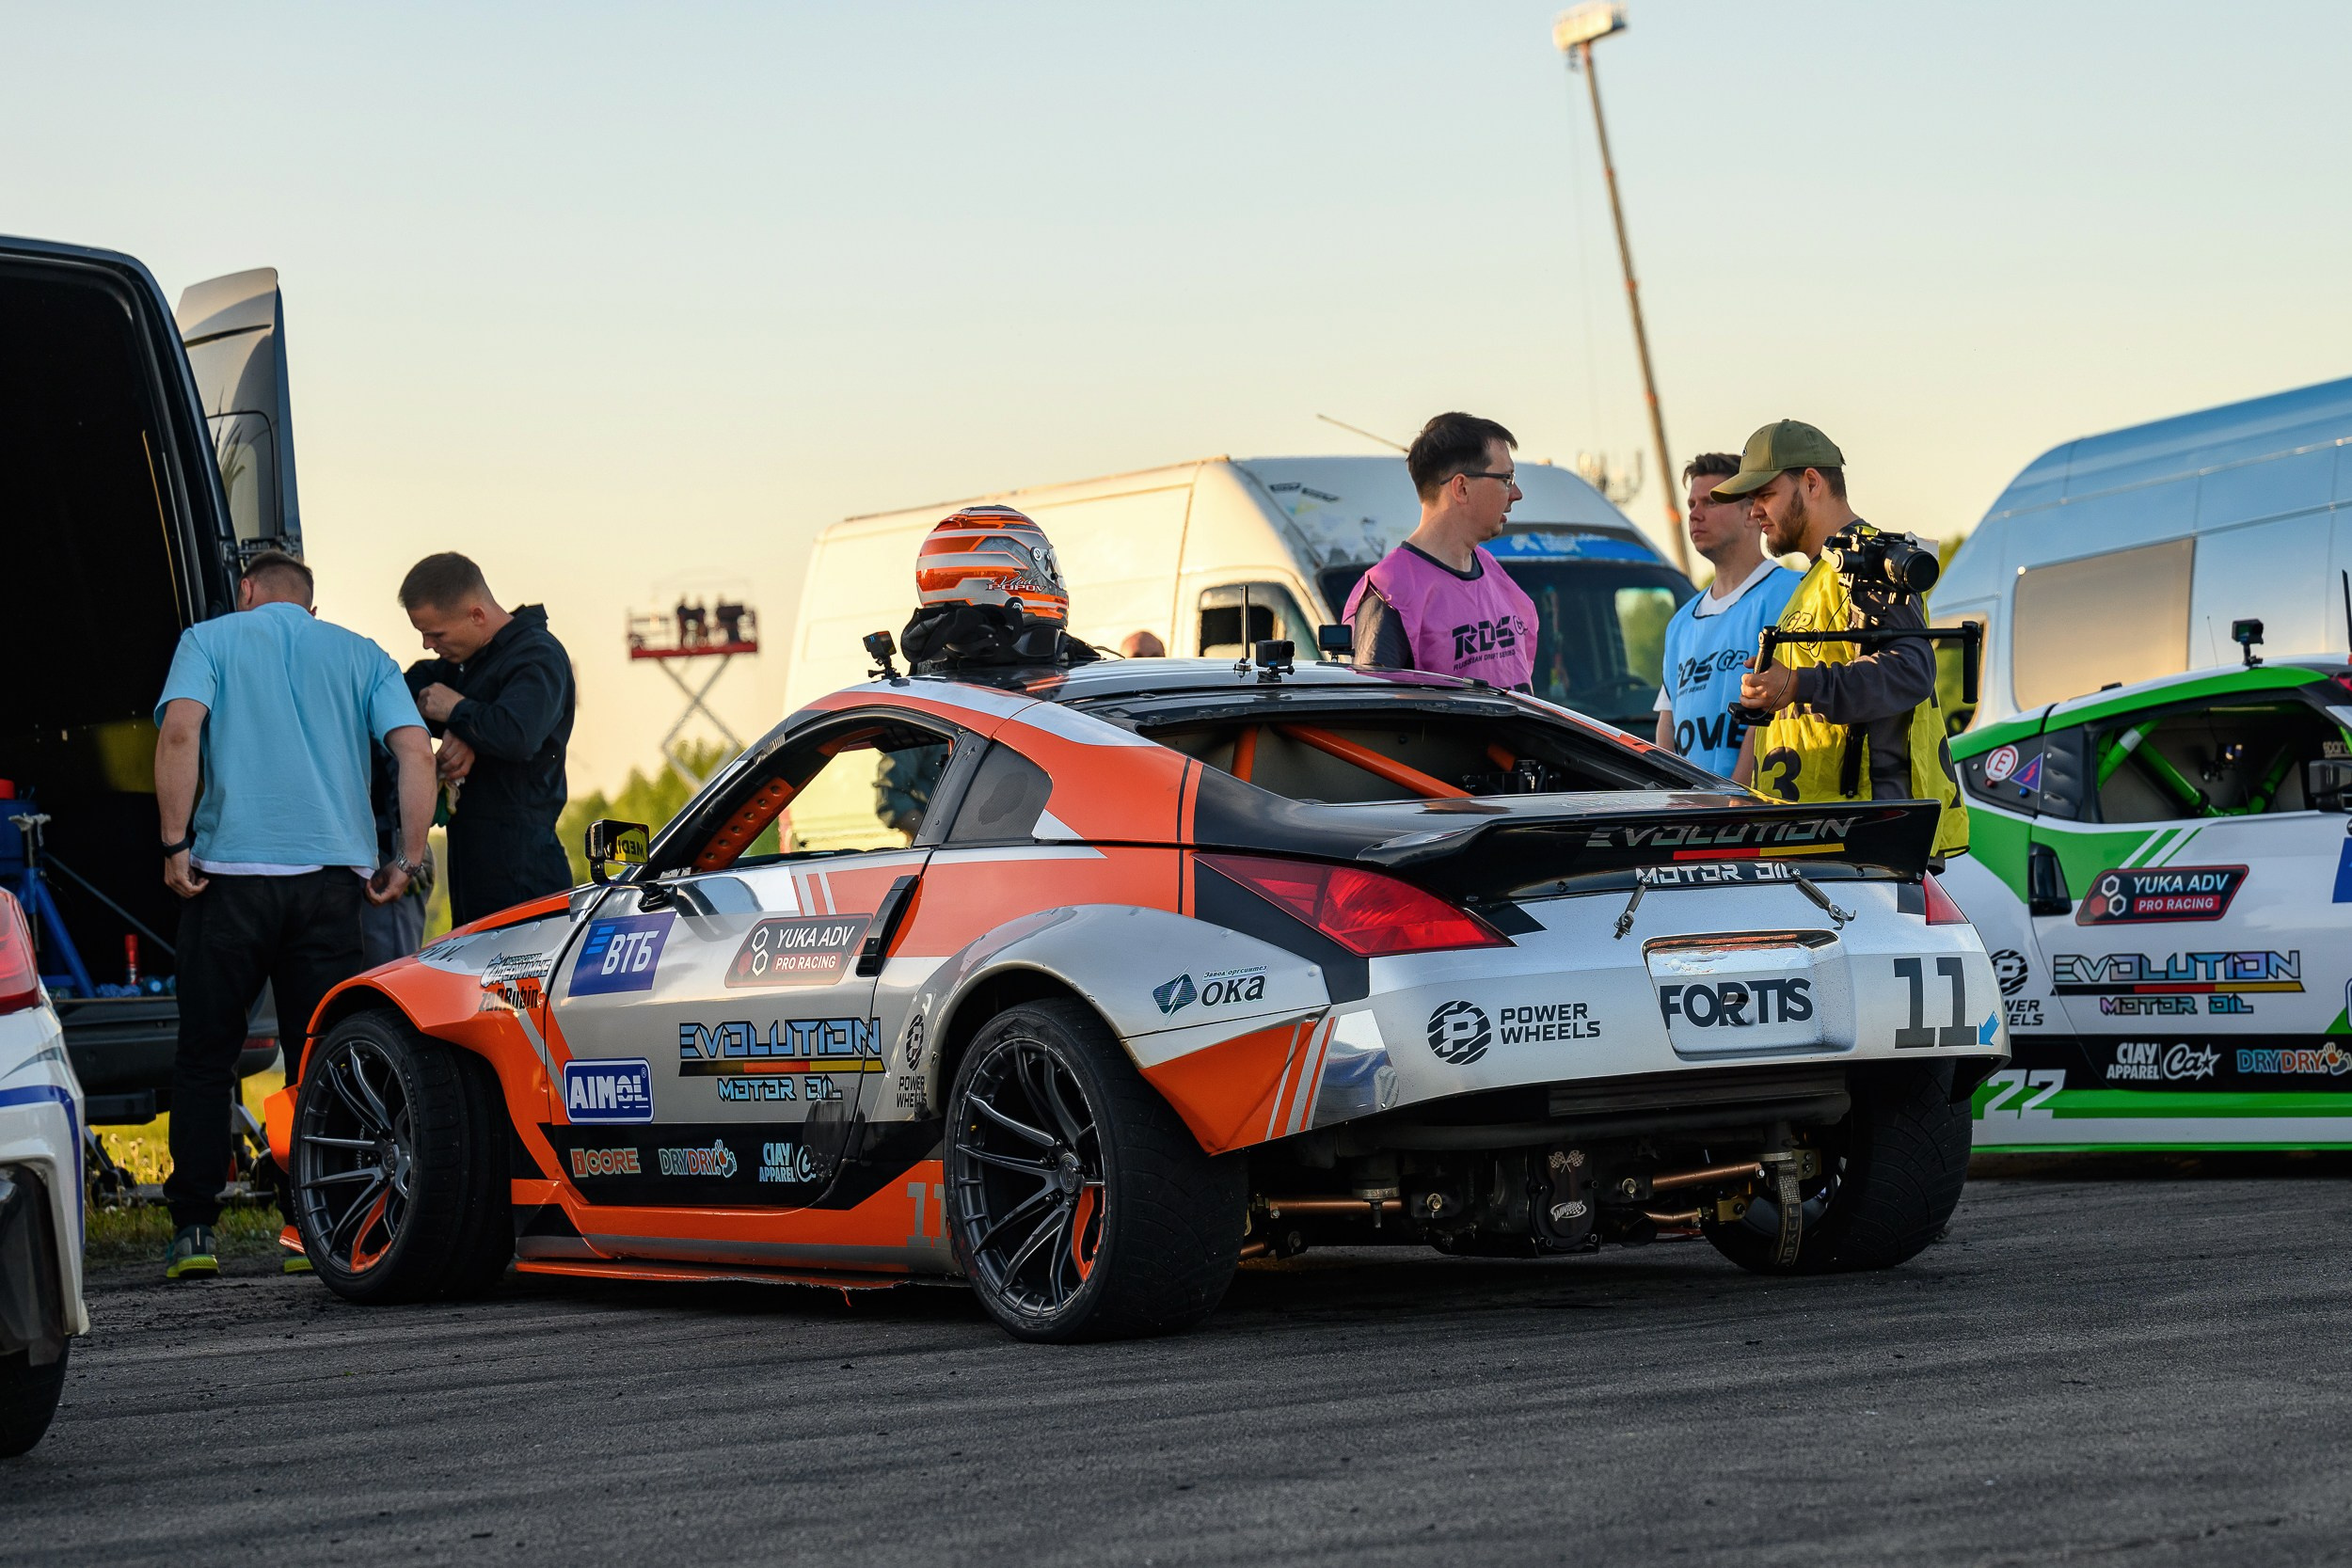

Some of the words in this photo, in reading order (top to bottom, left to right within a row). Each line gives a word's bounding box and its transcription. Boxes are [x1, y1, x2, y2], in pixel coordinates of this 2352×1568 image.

[1452, 615, 1515, 661] RDS
[1453, 653, 1484, 672] RUSSIAN
[1586, 816, 1864, 847] EVOLUTION
[1635, 863, 1742, 884] MOTOR
[2133, 875, 2184, 894] YUKA
[2186, 874, 2230, 893] ADV
[2138, 897, 2163, 911] PRO
[2166, 896, 2215, 911] RACING
[776, 926, 817, 949] YUKA
[817, 925, 856, 948] ADV
[600, 929, 660, 975] ВТБ
[774, 954, 797, 971] PRO
[797, 953, 837, 971] RACING
[2053, 950, 2300, 982] EVOLUTION
[1501, 1002, 1588, 1026] POWER
[1660, 977, 1814, 1030] FORTIS
[1894, 957, 1978, 1050] 11
[2100, 996, 2198, 1015] MOTOR
[2209, 993, 2254, 1015] OIL
[679, 1016, 883, 1060] EVOLUTION
[1501, 1020, 1601, 1045] WHEELS
[898, 1075, 926, 1091] POWER
[2106, 1063, 2160, 1081] APPAREL
[569, 1074, 649, 1109] AIMOL
[717, 1076, 797, 1102] MOTOR
[804, 1072, 844, 1101] OIL
[1982, 1068, 2067, 1120] 22
[758, 1165, 797, 1183] APPAREL
[907, 1181, 952, 1250] 11
